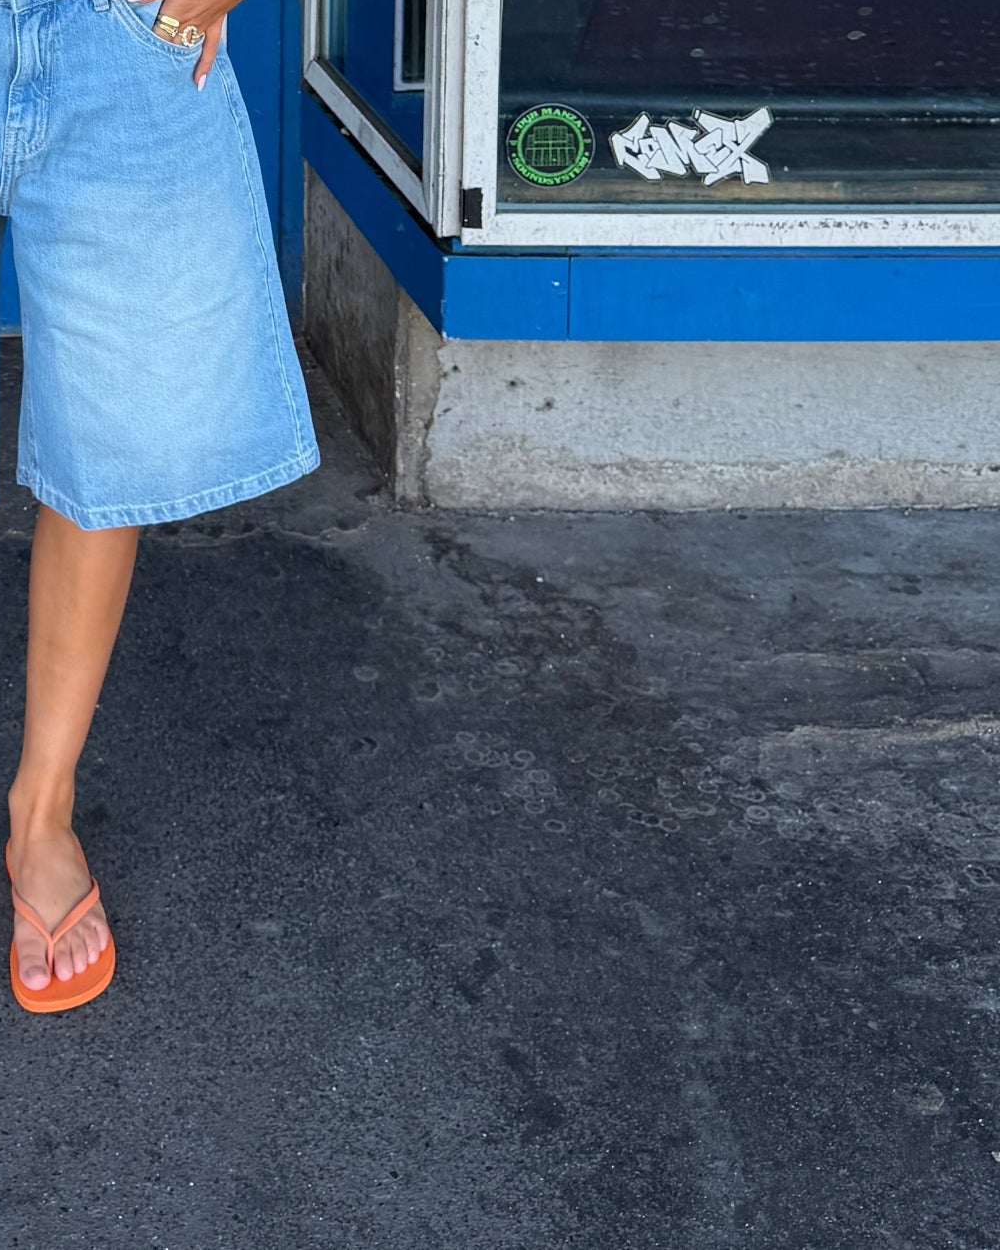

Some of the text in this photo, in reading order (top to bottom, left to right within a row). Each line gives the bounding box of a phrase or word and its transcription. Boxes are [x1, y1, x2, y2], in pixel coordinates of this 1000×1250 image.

[517, 108, 582, 129] DUB MANZA
[513, 157, 589, 185] SOUNDSYSTEM
